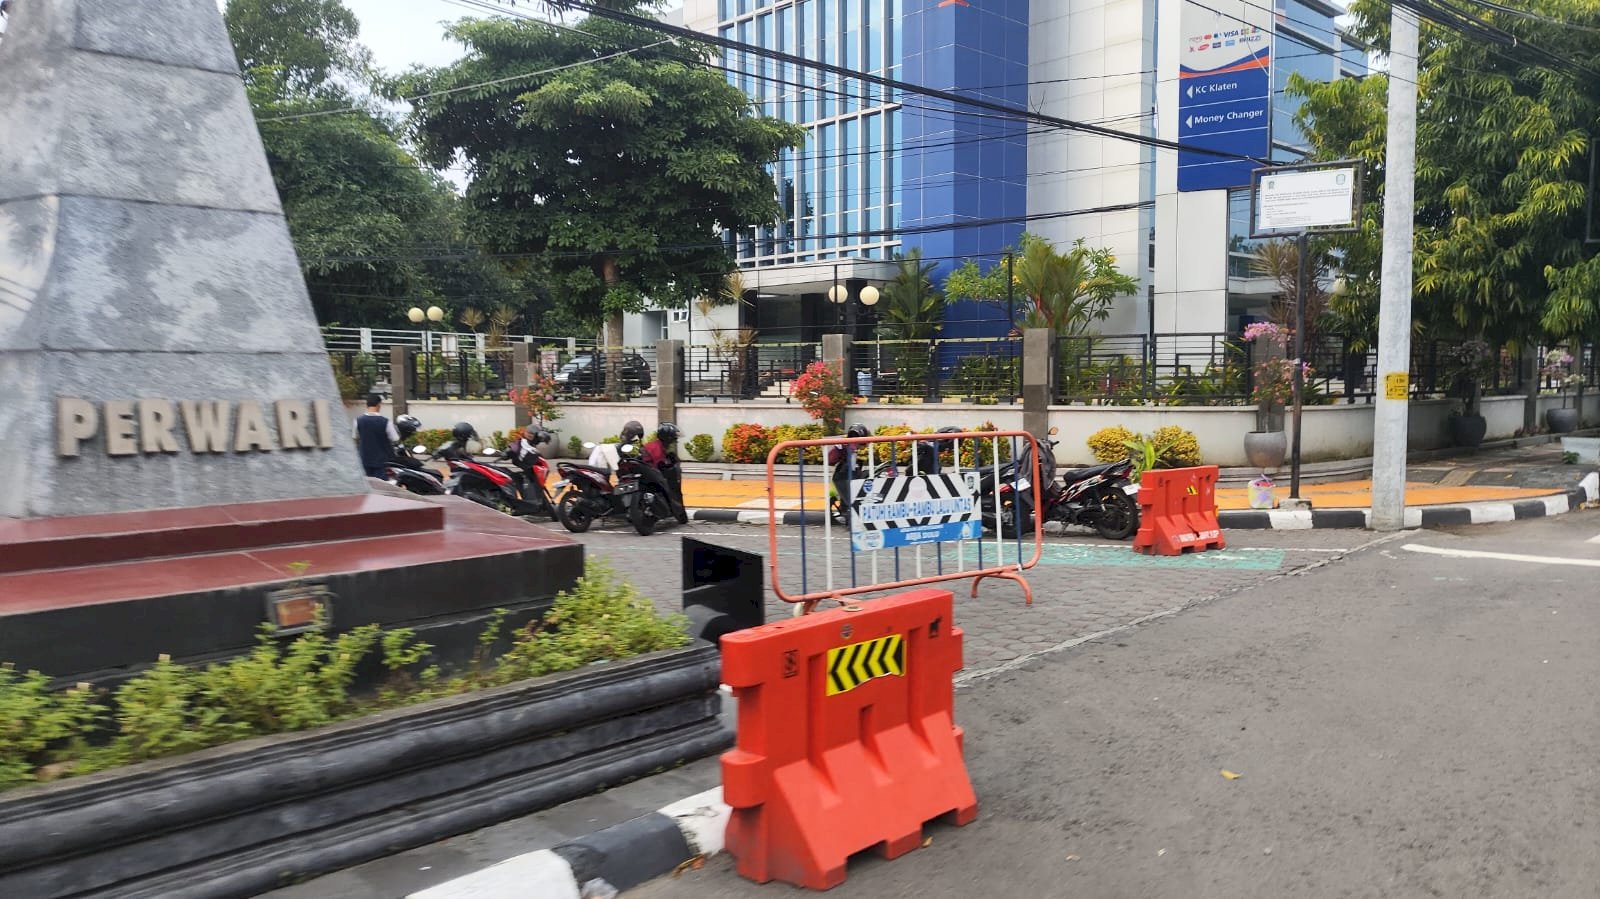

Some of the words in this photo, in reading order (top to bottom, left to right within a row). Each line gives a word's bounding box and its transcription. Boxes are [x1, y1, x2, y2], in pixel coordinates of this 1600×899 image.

[1223, 30, 1239, 38] VISA
[1195, 86, 1208, 94] KC
[1209, 83, 1237, 92] Klaten
[1194, 115, 1224, 124] Money
[1226, 110, 1264, 119] Changer
[58, 398, 334, 456] PERWARI
